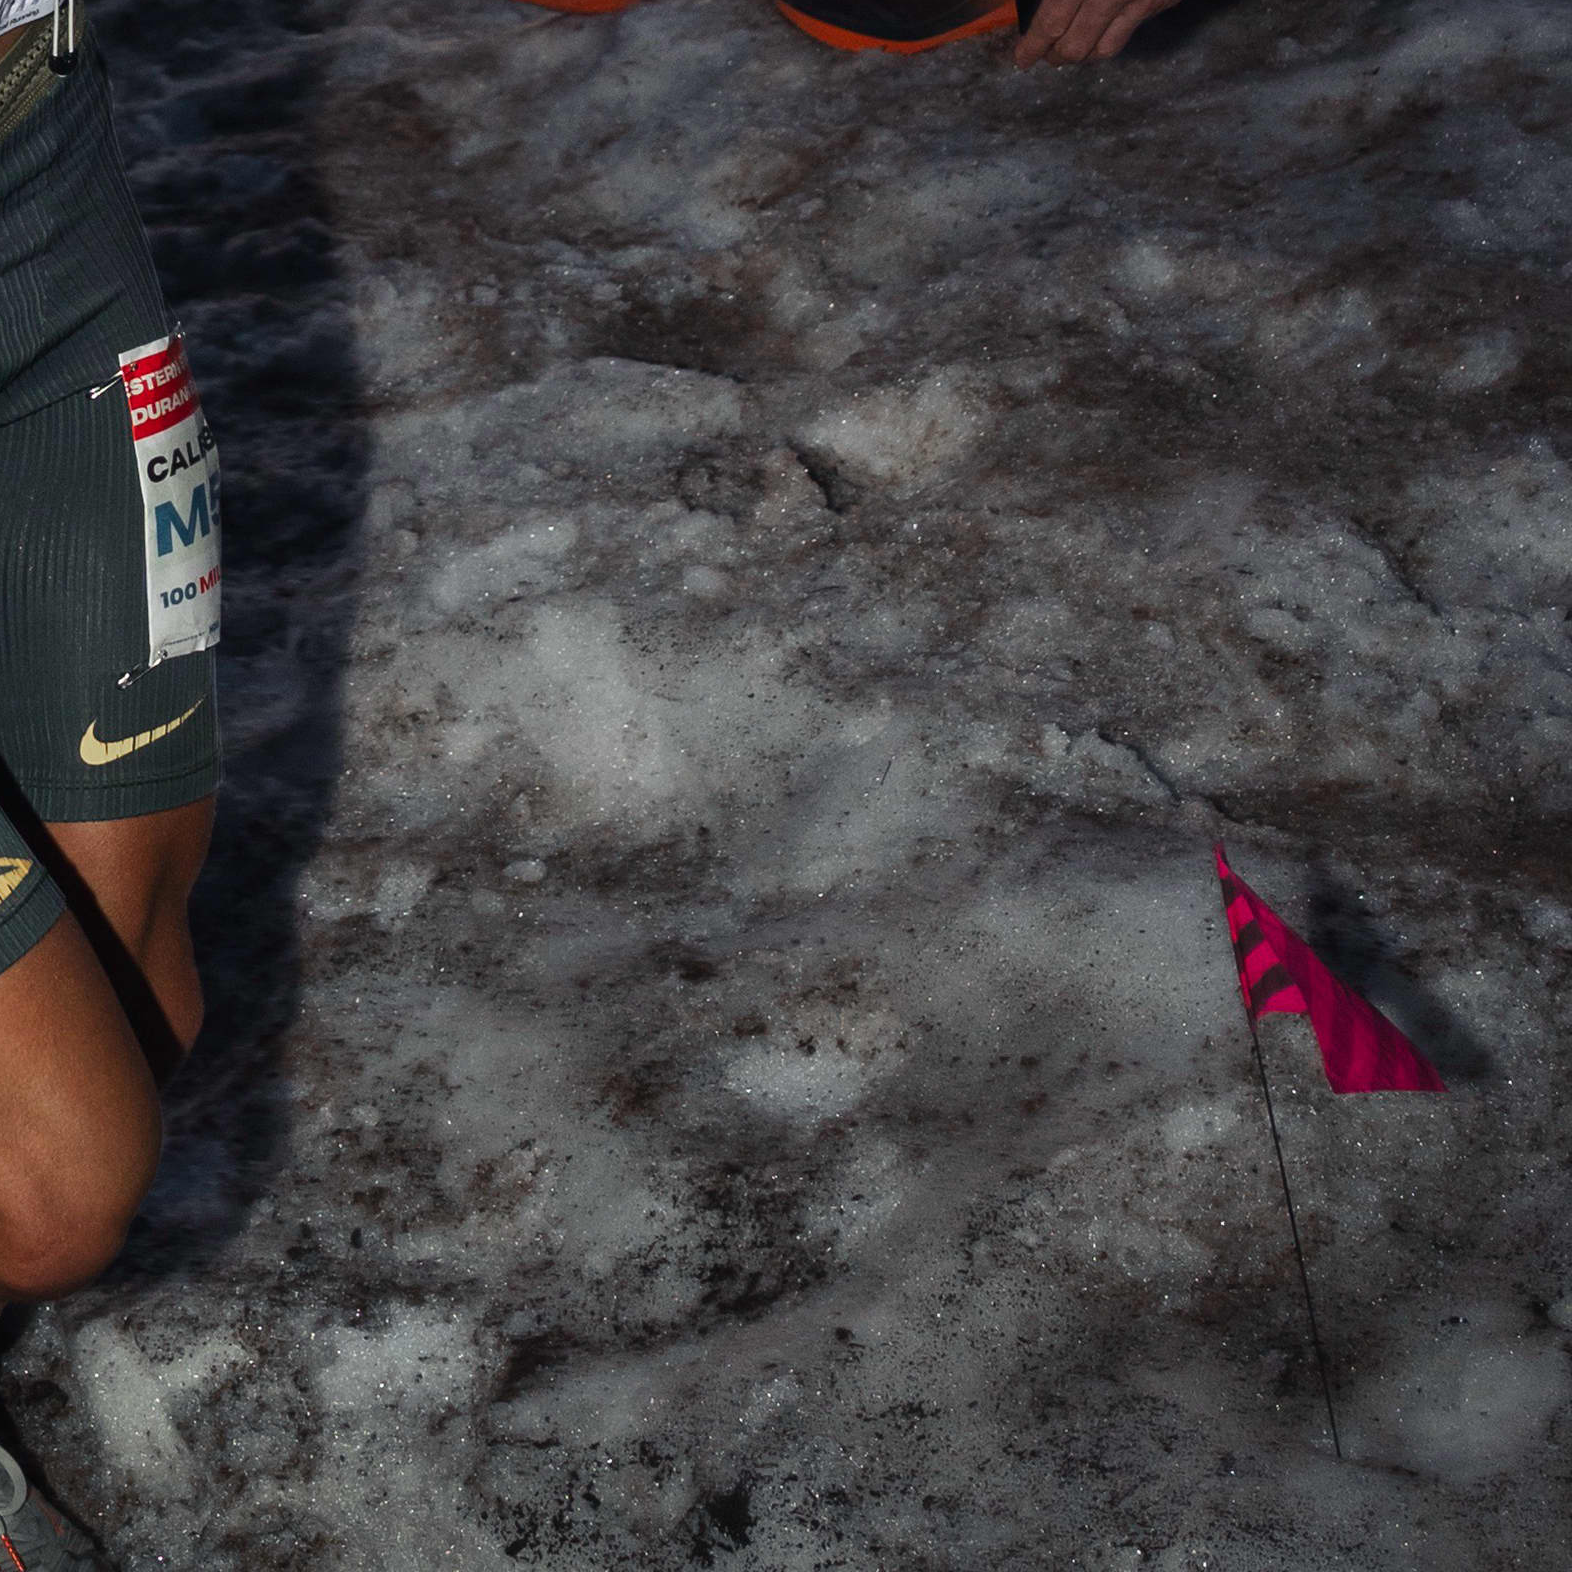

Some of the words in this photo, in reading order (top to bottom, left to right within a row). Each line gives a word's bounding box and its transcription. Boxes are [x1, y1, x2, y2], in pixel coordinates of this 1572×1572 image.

[124, 361, 182, 398] STERN
[131, 383, 196, 427] DURAN
[160, 582, 197, 609] 100
[199, 564, 221, 595] MIL
